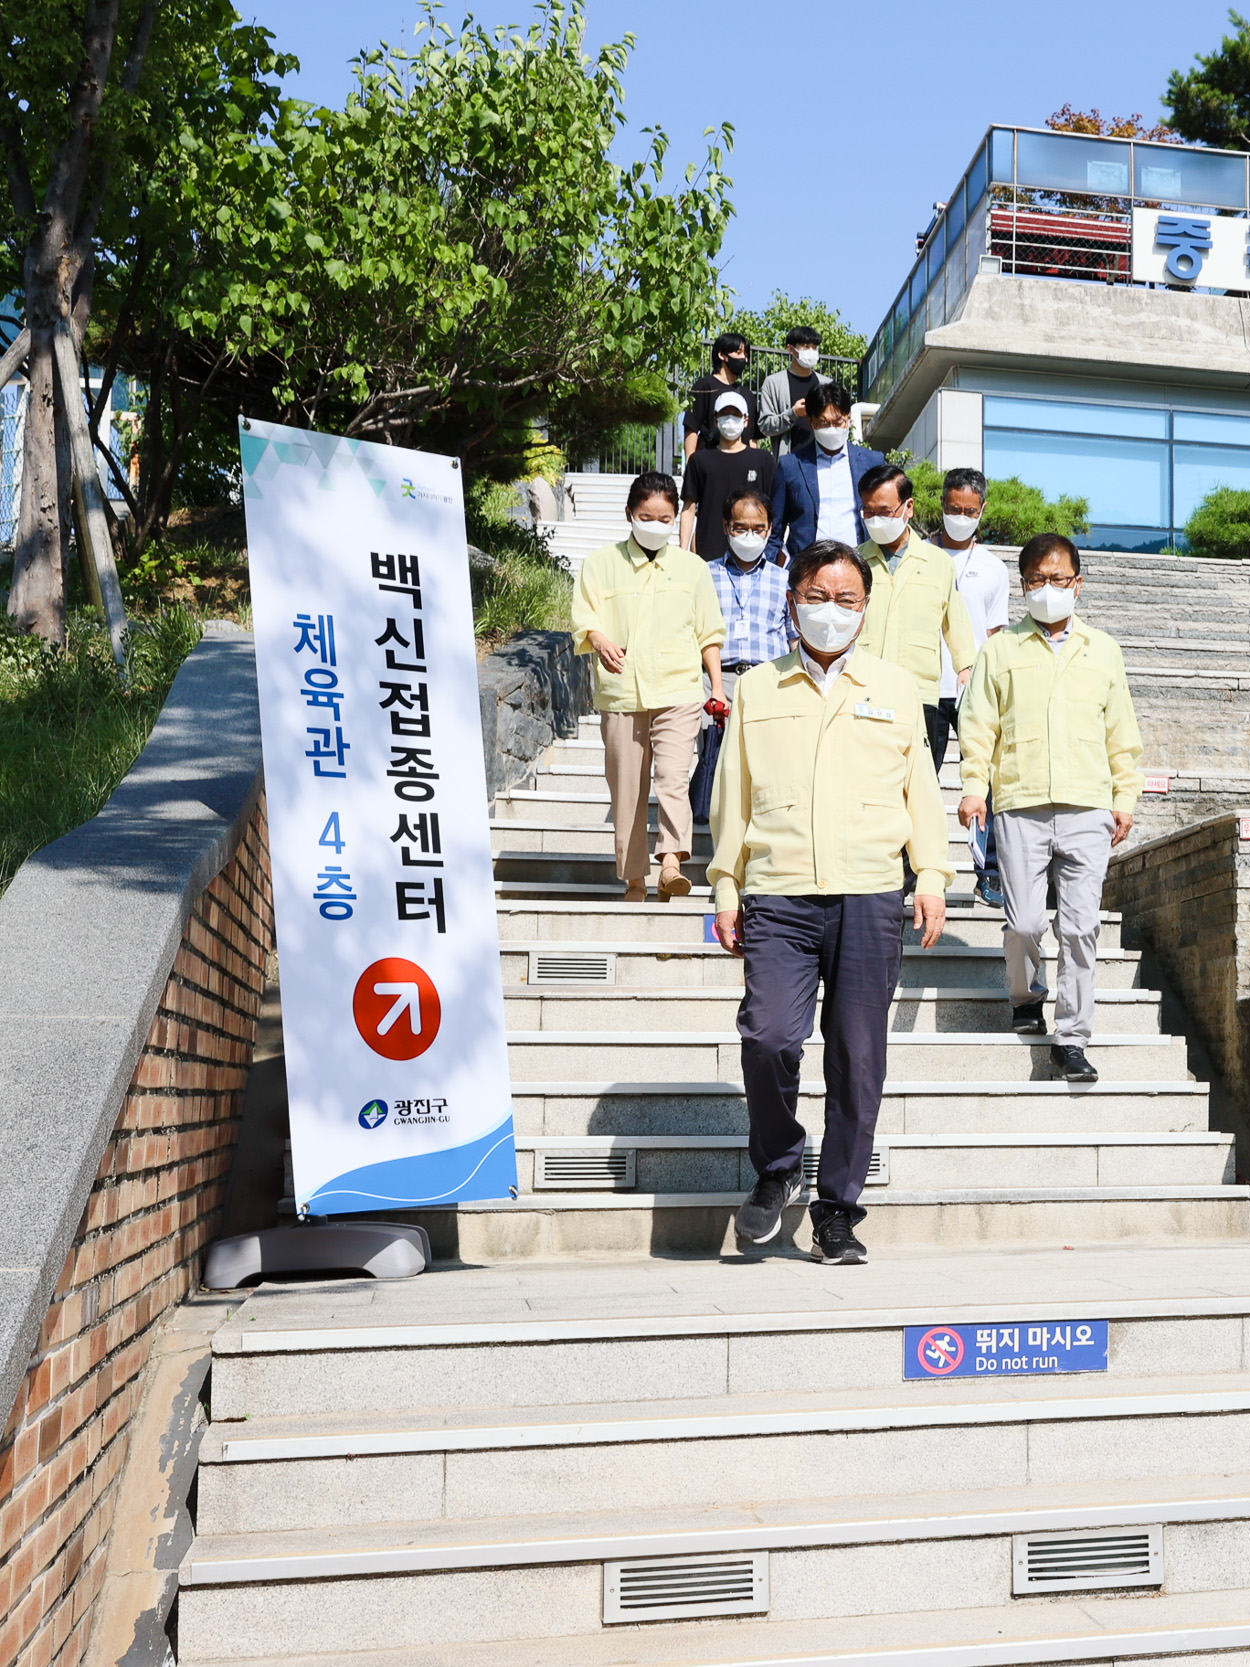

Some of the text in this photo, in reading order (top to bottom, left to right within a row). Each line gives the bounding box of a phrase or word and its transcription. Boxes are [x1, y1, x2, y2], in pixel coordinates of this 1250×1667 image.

[369, 551, 449, 935] 백신접종센터
[292, 612, 358, 922] 체육관 4층
[394, 1098, 449, 1117] 광진구
[393, 1115, 451, 1126] GWANGJIN-GU
[975, 1325, 1095, 1354] 뛰지 마시오
[975, 1355, 1059, 1372] Do not run
